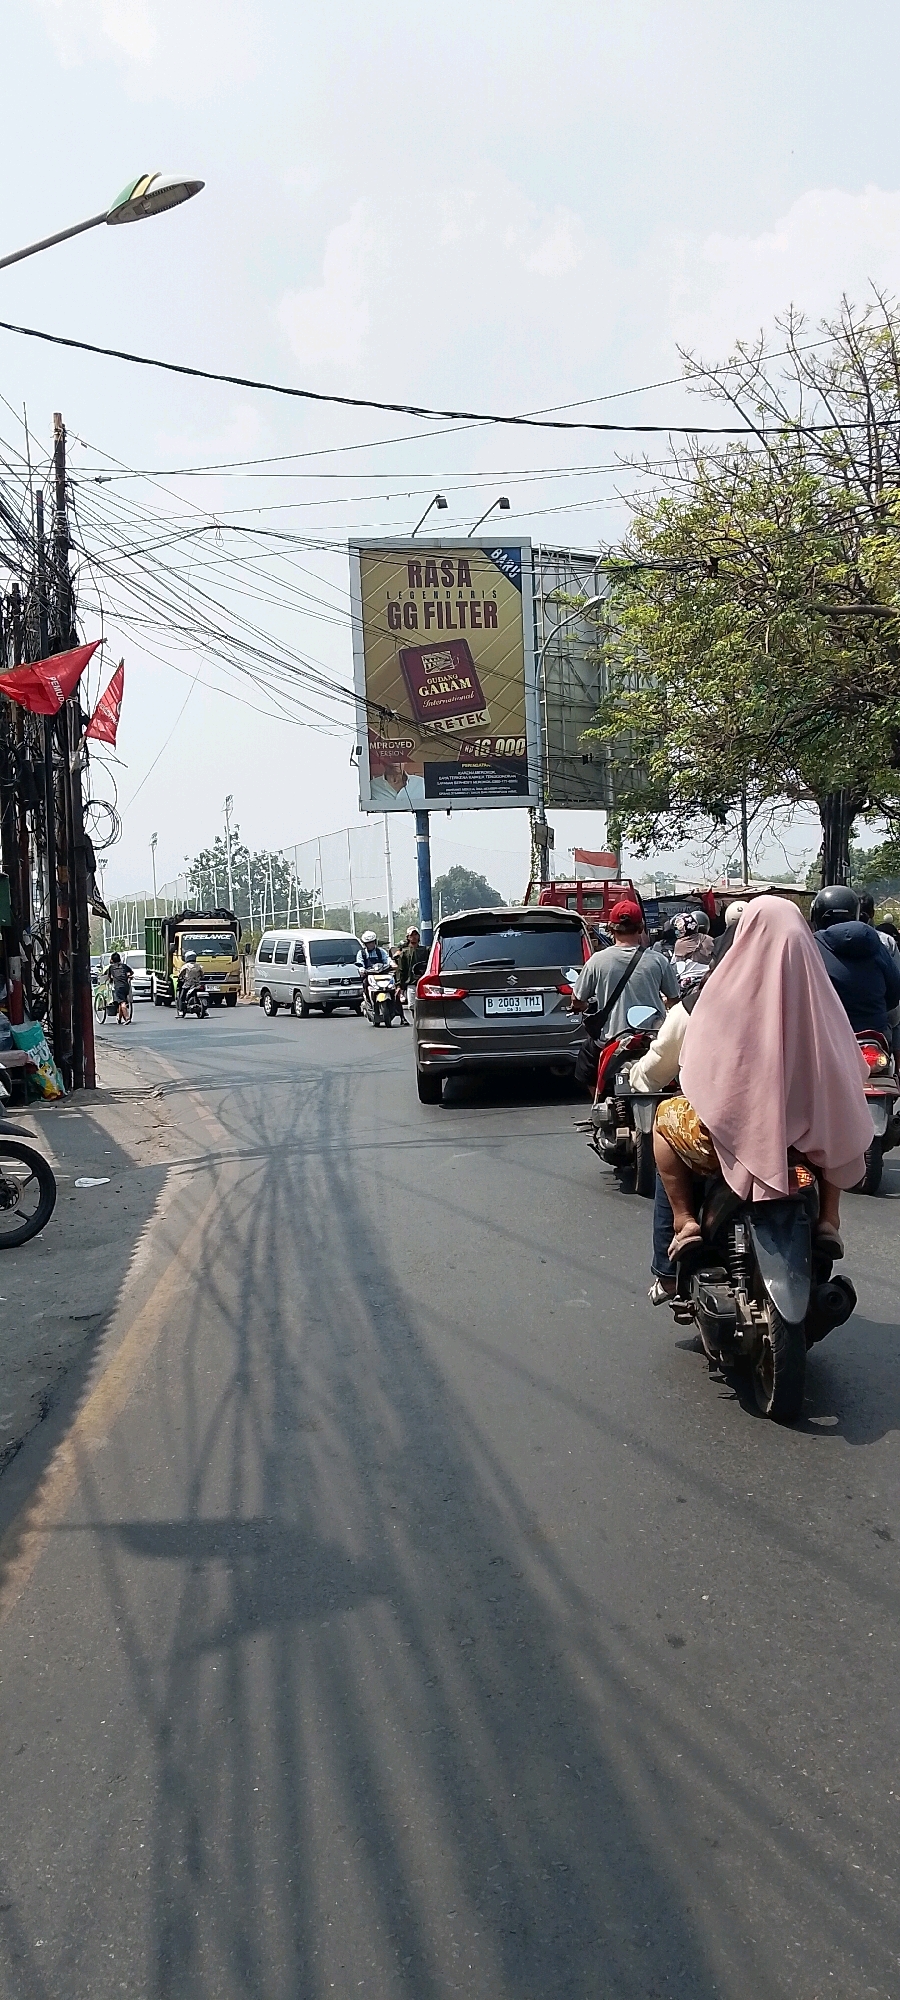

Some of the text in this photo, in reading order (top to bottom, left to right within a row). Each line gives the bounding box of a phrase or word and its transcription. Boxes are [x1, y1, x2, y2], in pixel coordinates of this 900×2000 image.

[490, 548, 521, 578] BARU
[408, 559, 473, 588] RASA
[386, 589, 497, 600] LEGENDARIS
[387, 600, 499, 630] GG FILTER
[418, 677, 472, 697] GARAM
[426, 674, 458, 684] GUDANG
[422, 690, 475, 708] International
[488, 996, 541, 1008] B 2003 TMI
